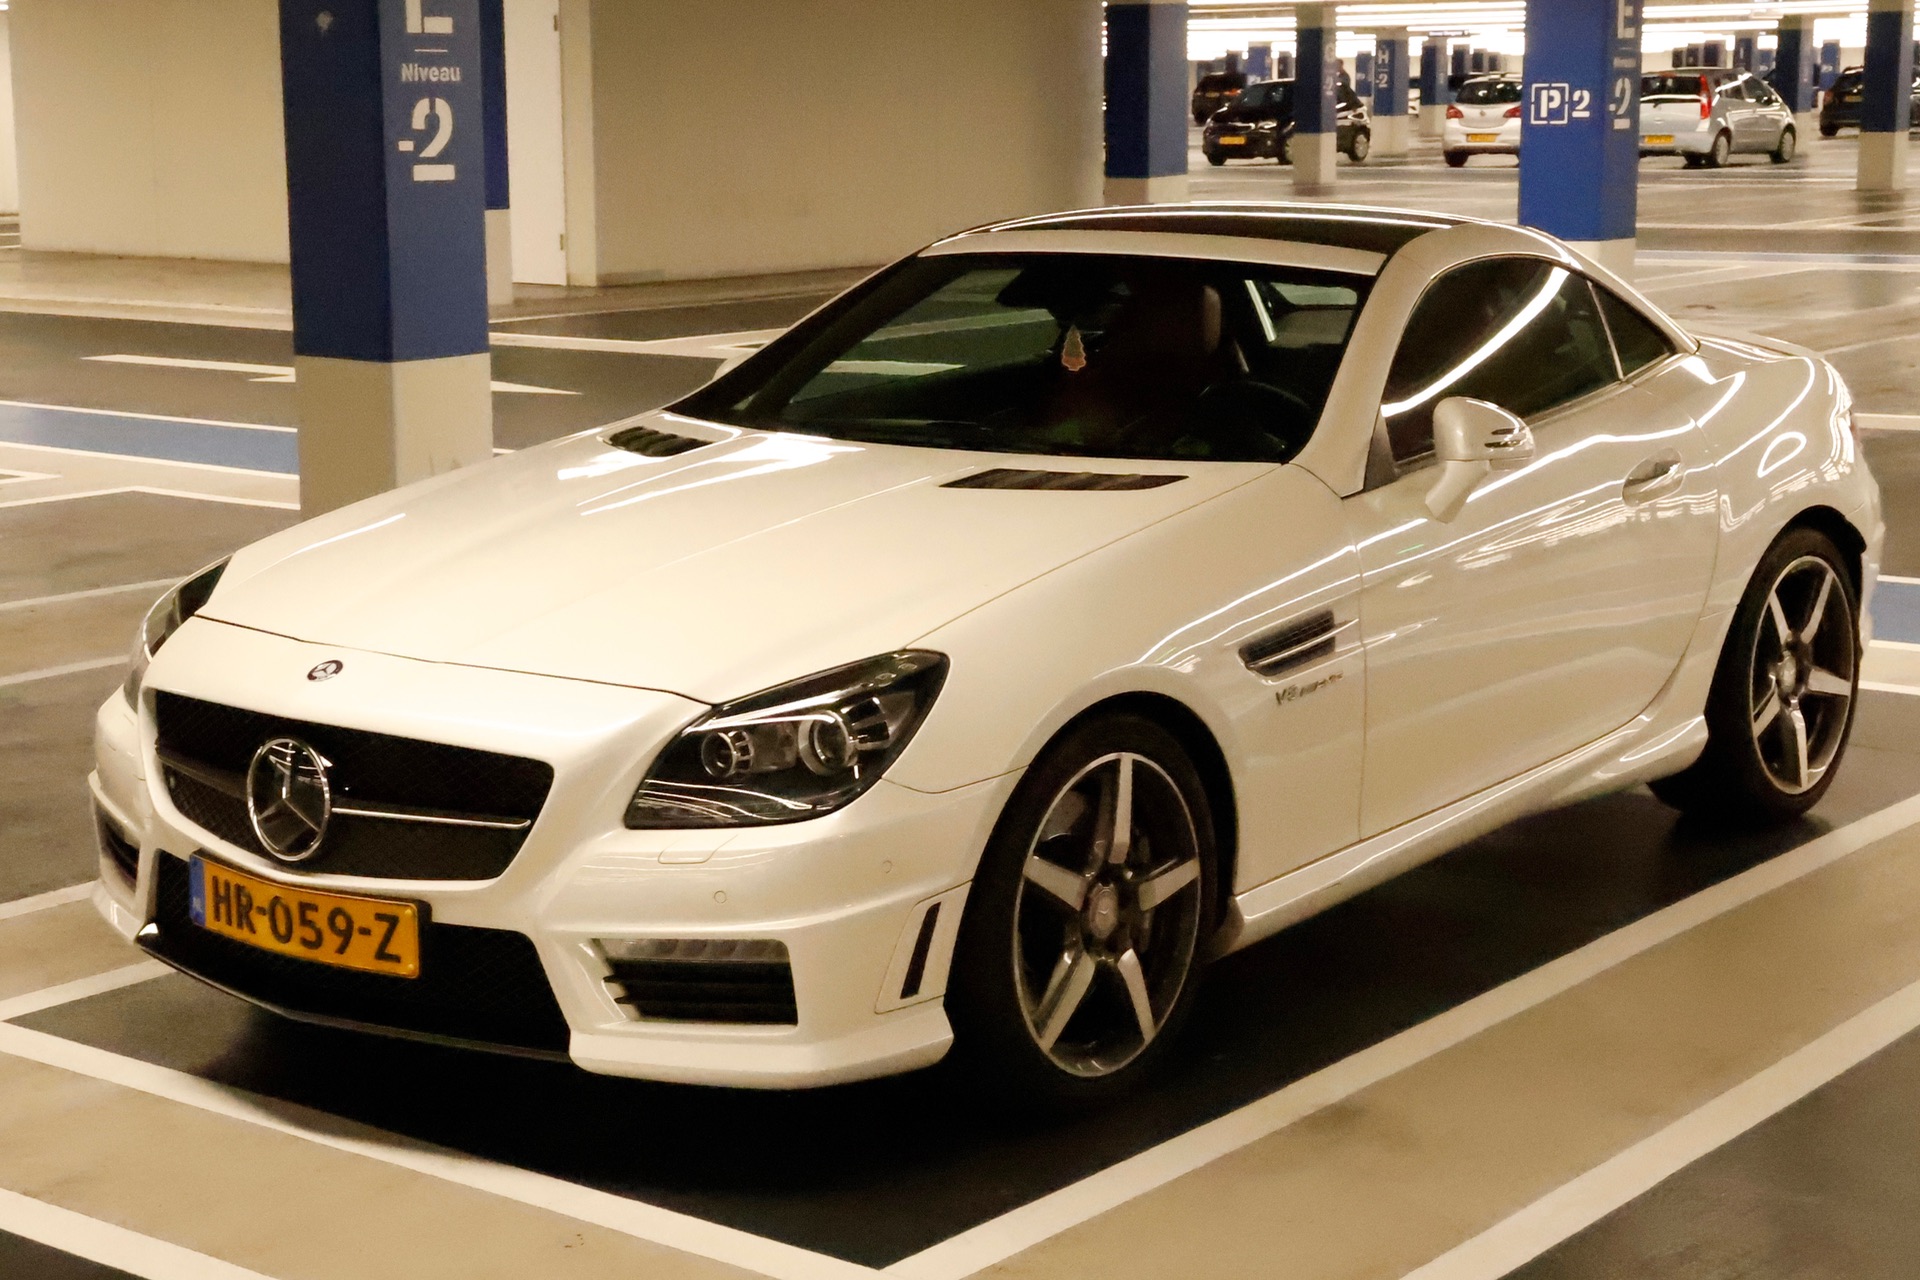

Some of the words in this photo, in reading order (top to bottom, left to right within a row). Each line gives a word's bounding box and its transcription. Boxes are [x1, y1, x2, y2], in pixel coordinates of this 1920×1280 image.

[401, 63, 461, 82] Niveau
[1378, 49, 1389, 64] H
[398, 97, 456, 182] -2
[211, 875, 402, 963] HR-059-Z
